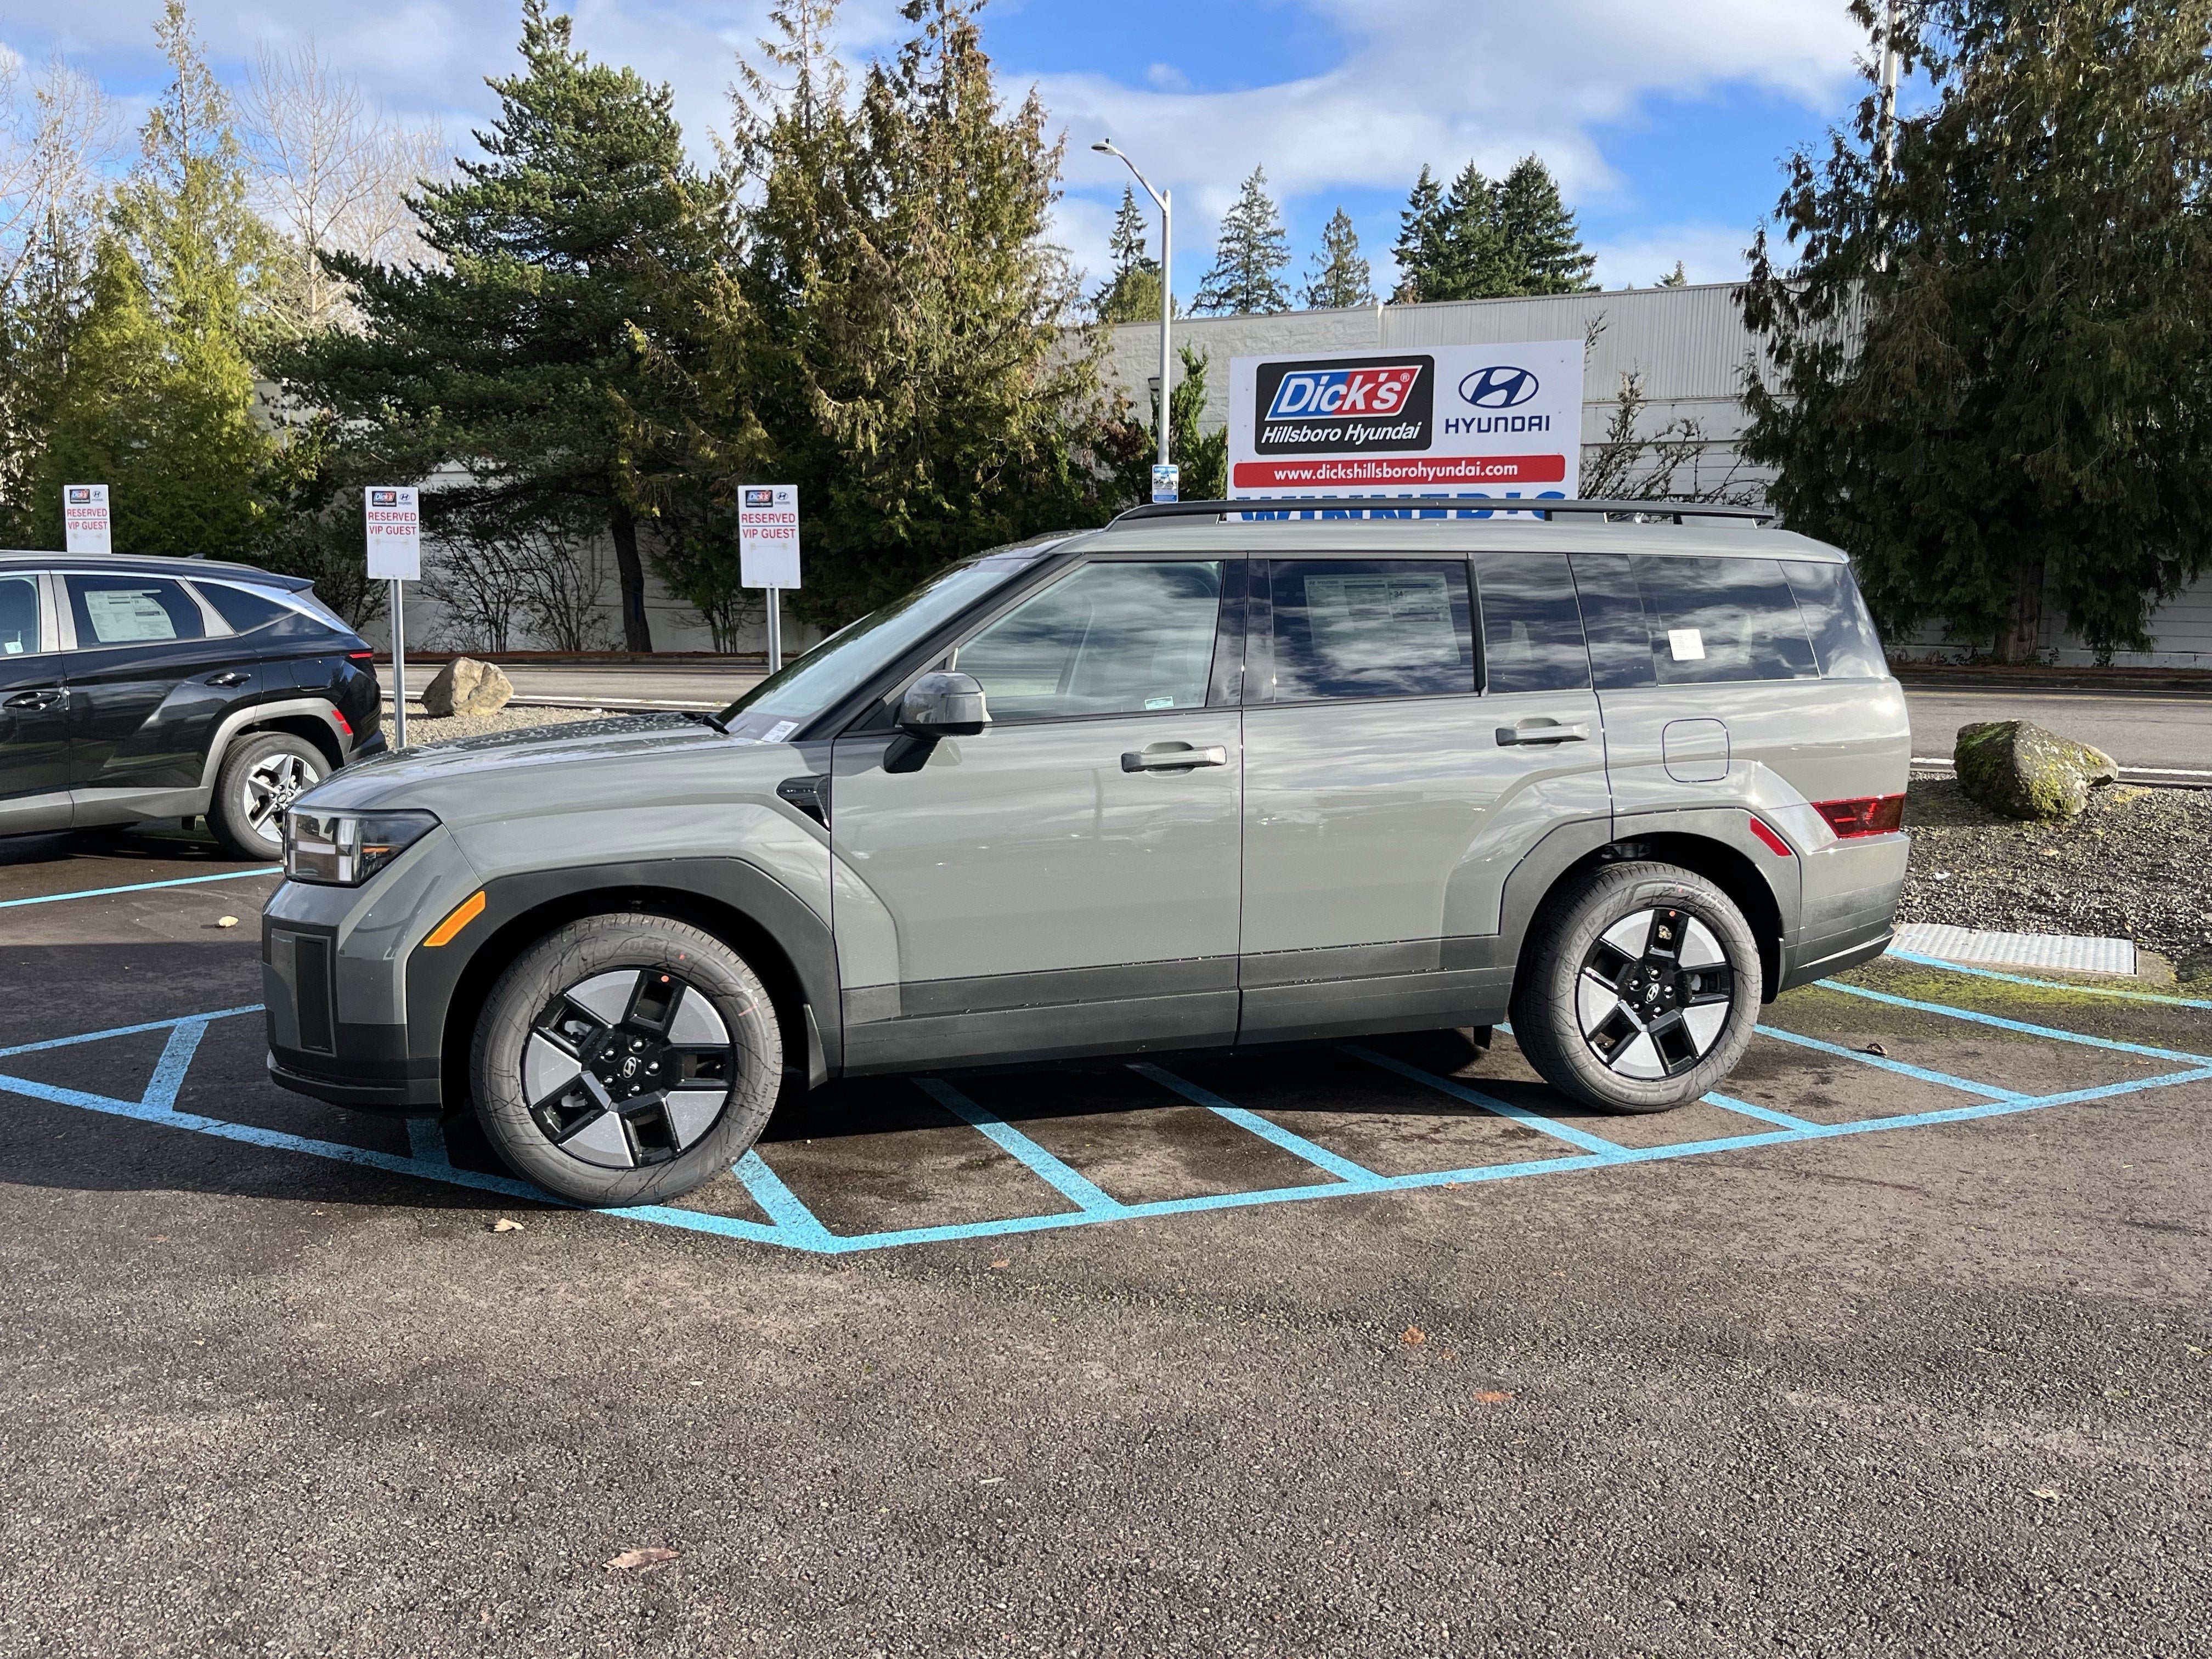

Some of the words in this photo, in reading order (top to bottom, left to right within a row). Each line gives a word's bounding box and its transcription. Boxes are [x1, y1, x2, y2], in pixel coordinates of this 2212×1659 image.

[1445, 415, 1550, 434] HYUNDAI
[1261, 425, 1342, 443] Hillsboro
[1344, 421, 1422, 445] Hyundai
[1274, 461, 1518, 481] www.dickshillsborohyundai.com
[67, 508, 107, 517] RESERVED
[368, 512, 416, 521] RESERVED
[742, 514, 795, 523] RESERVED
[68, 522, 80, 530] VIP
[82, 521, 108, 530] GUEST
[369, 526, 383, 534] VIP
[386, 526, 417, 535] GUEST
[743, 529, 758, 538] VIP
[761, 528, 795, 538] GUEST
